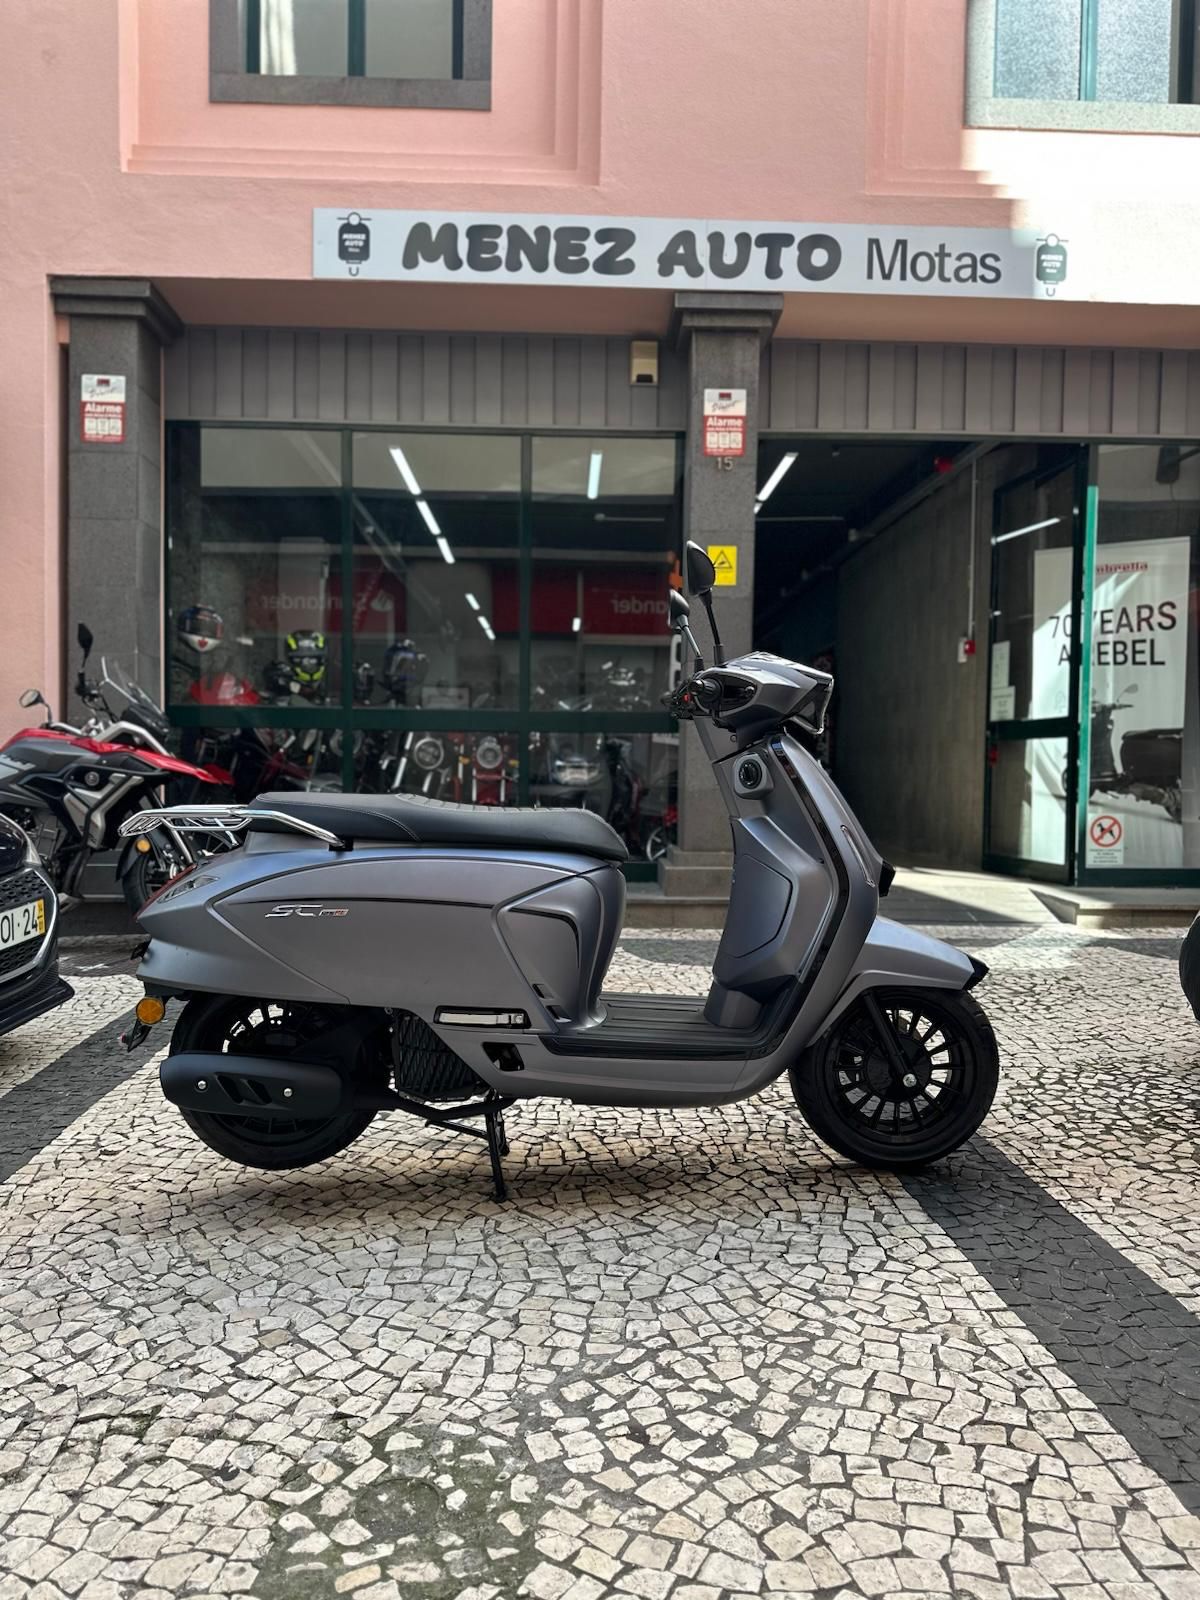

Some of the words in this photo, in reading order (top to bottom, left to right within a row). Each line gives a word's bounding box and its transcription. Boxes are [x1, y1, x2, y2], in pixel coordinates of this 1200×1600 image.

[402, 221, 636, 276] MENEZ
[657, 229, 842, 281] AUTO
[866, 237, 1002, 284] Motas
[84, 402, 123, 414] Alarme
[706, 416, 743, 427] Alarme
[716, 456, 734, 471] 15
[1048, 614, 1072, 639] 70
[1092, 600, 1178, 635] EARS
[1092, 638, 1166, 667] EBEL
